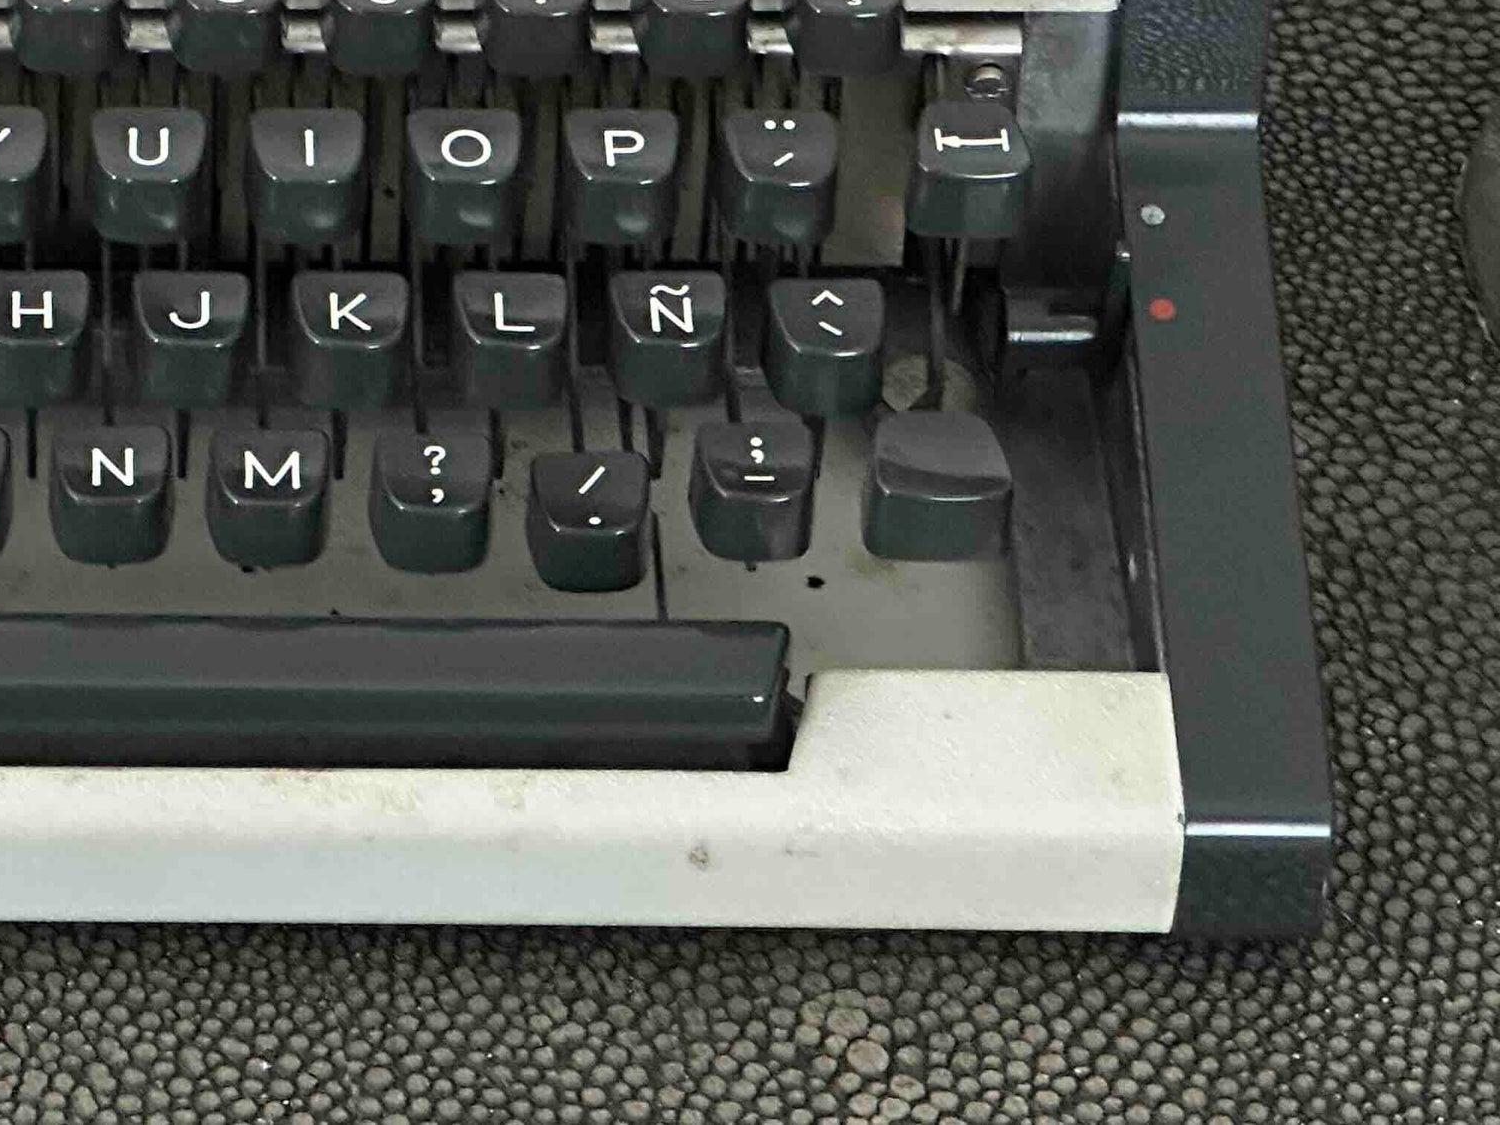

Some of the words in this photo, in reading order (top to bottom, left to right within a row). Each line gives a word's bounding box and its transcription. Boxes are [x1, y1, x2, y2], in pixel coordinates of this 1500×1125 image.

[128, 127, 170, 166] U
[304, 128, 315, 167] I
[440, 129, 492, 168] O
[603, 129, 645, 167] P
[11, 290, 53, 329] H
[169, 290, 211, 330] J
[329, 292, 372, 331] K
[493, 292, 536, 332] L
[649, 284, 694, 333] Ñ
[91, 447, 134, 487] N
[244, 450, 301, 490] M
[423, 445, 446, 475] ?
